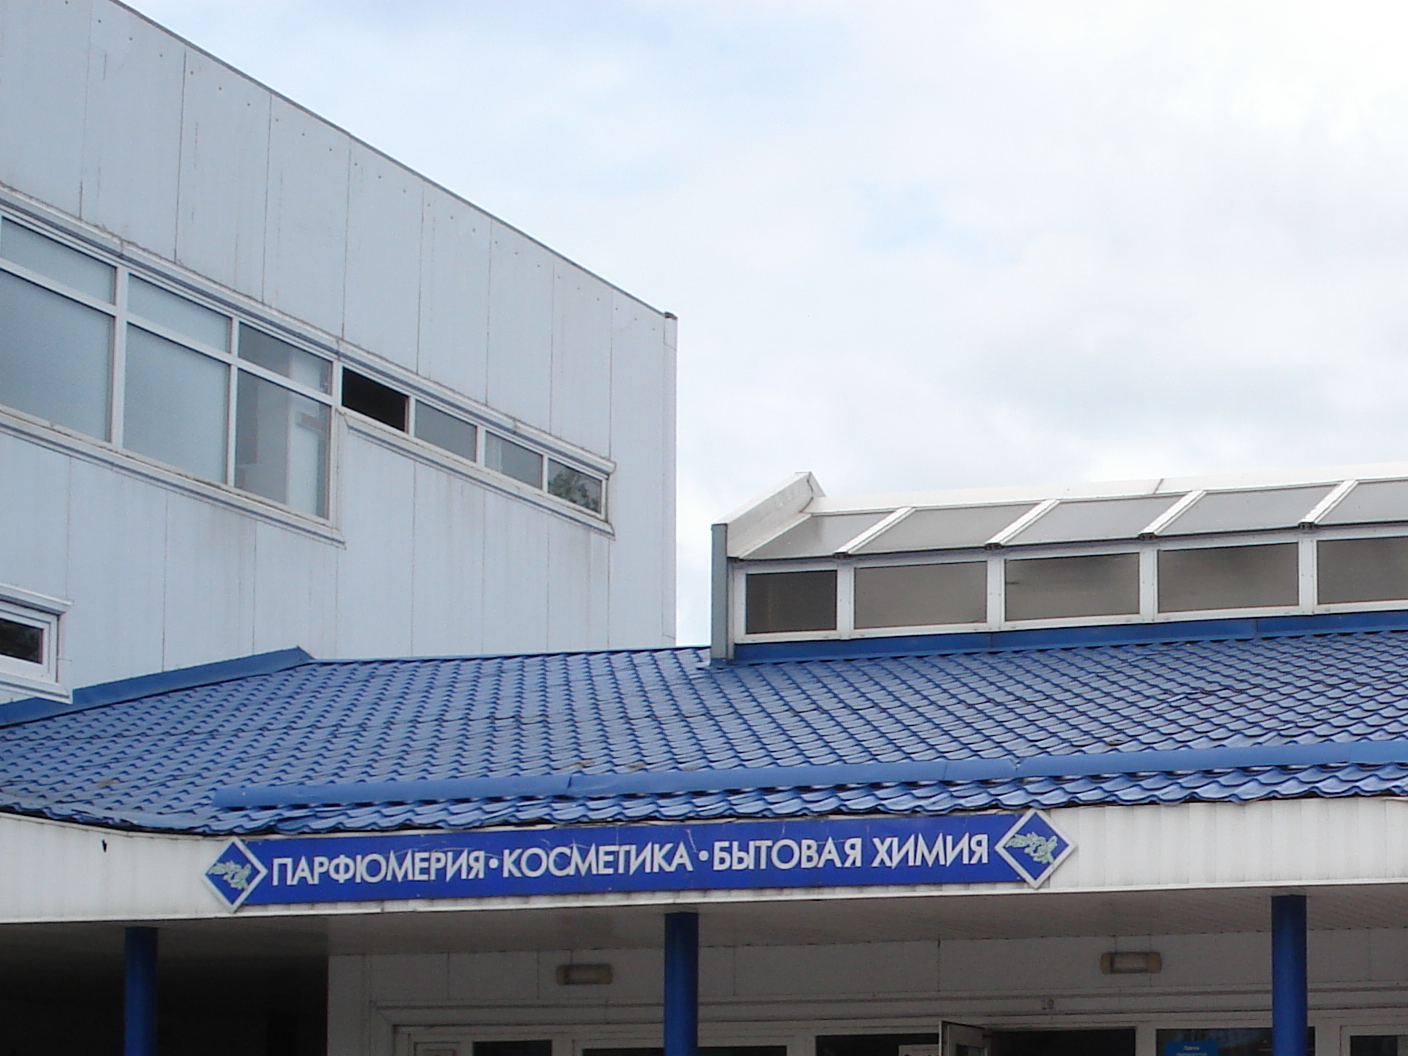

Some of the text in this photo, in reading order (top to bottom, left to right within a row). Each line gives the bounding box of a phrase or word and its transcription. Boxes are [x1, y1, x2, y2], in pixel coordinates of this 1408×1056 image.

[271, 832, 989, 887] ПАРФЮМЕРИЯ КОСМЕТИКА БЫТОВАЯ ХИМИЯ
